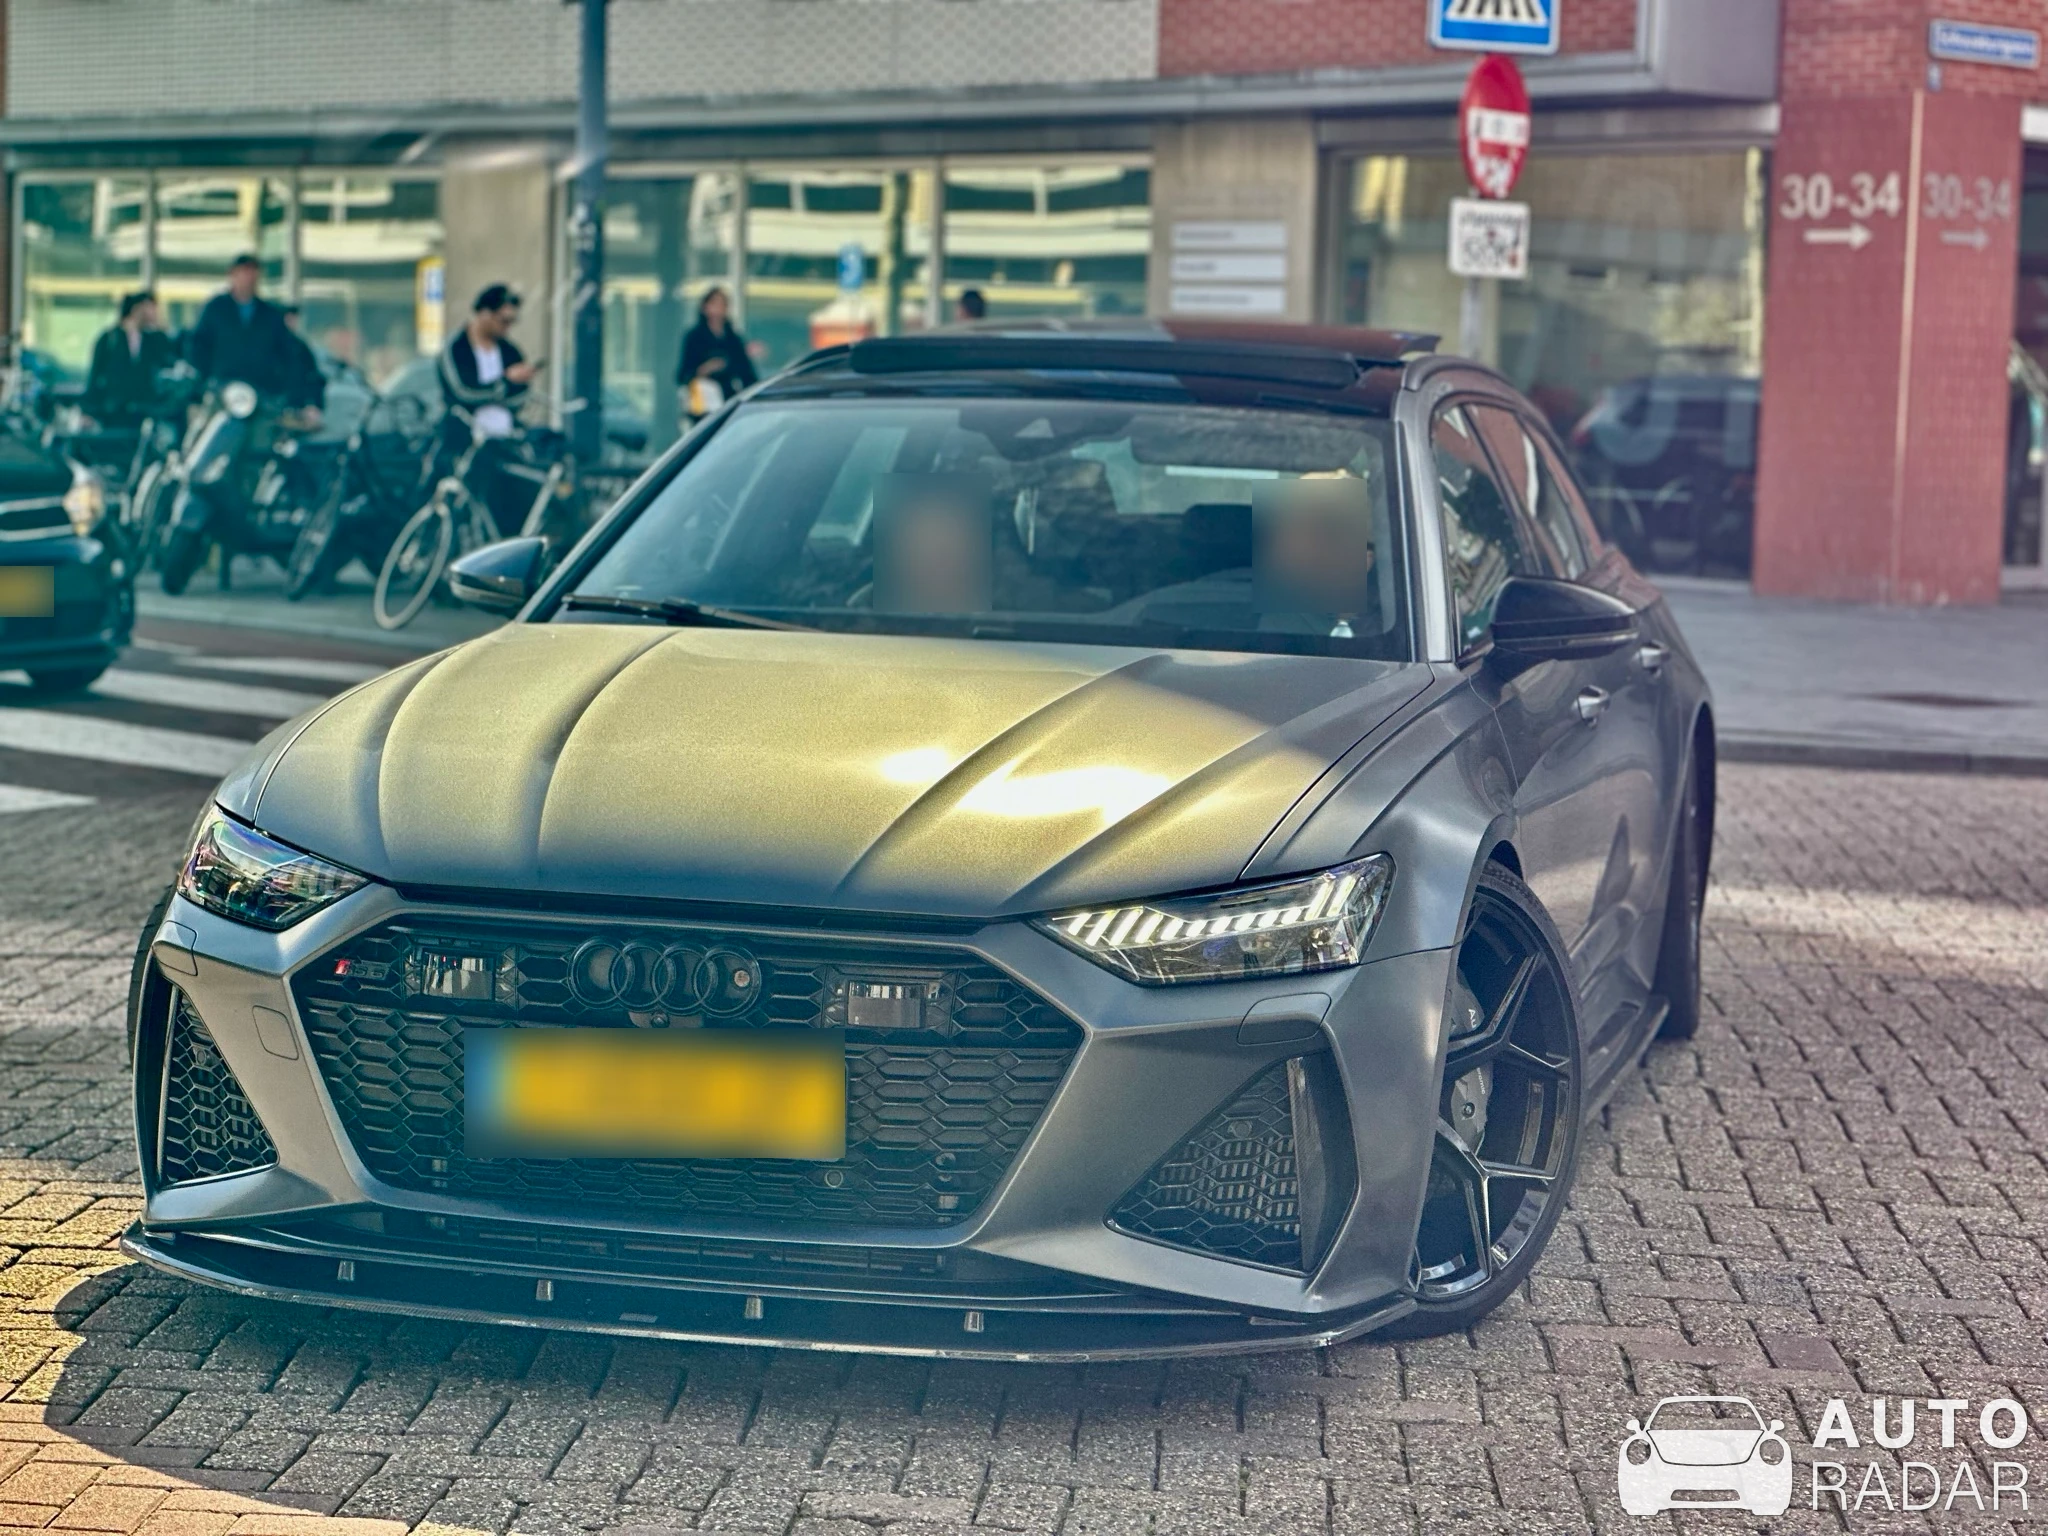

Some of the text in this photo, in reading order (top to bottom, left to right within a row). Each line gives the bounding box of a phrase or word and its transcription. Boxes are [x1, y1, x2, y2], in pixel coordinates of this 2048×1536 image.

[1779, 172, 1900, 220] 30-34
[1921, 171, 2012, 222] 30-34
[1467, 1008, 1477, 1029] Au
